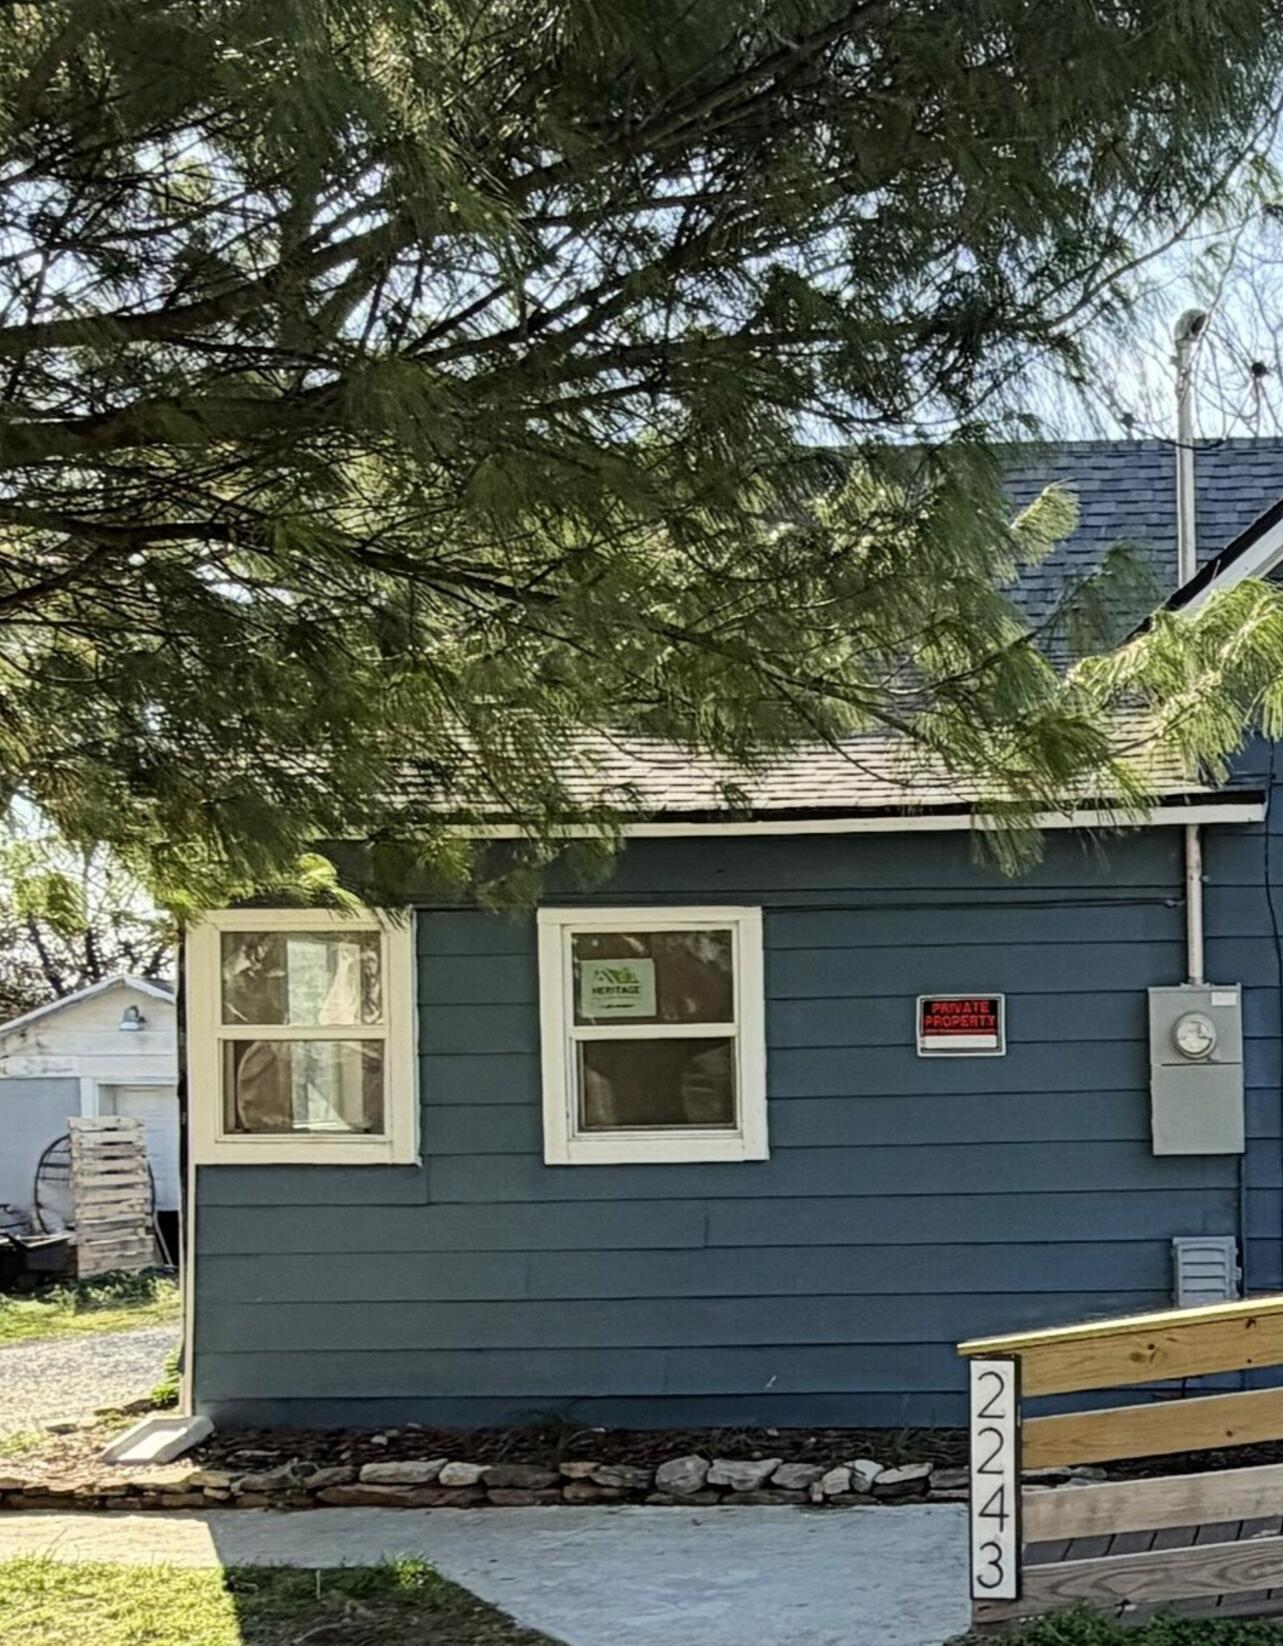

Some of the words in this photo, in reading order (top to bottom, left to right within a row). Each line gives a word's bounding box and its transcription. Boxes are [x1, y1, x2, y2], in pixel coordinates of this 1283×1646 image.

[592, 985, 642, 995] HERITAGE
[931, 1001, 990, 1014] PRIVATE
[924, 1014, 996, 1028] PROPERTY
[976, 1370, 1010, 1590] 2243
